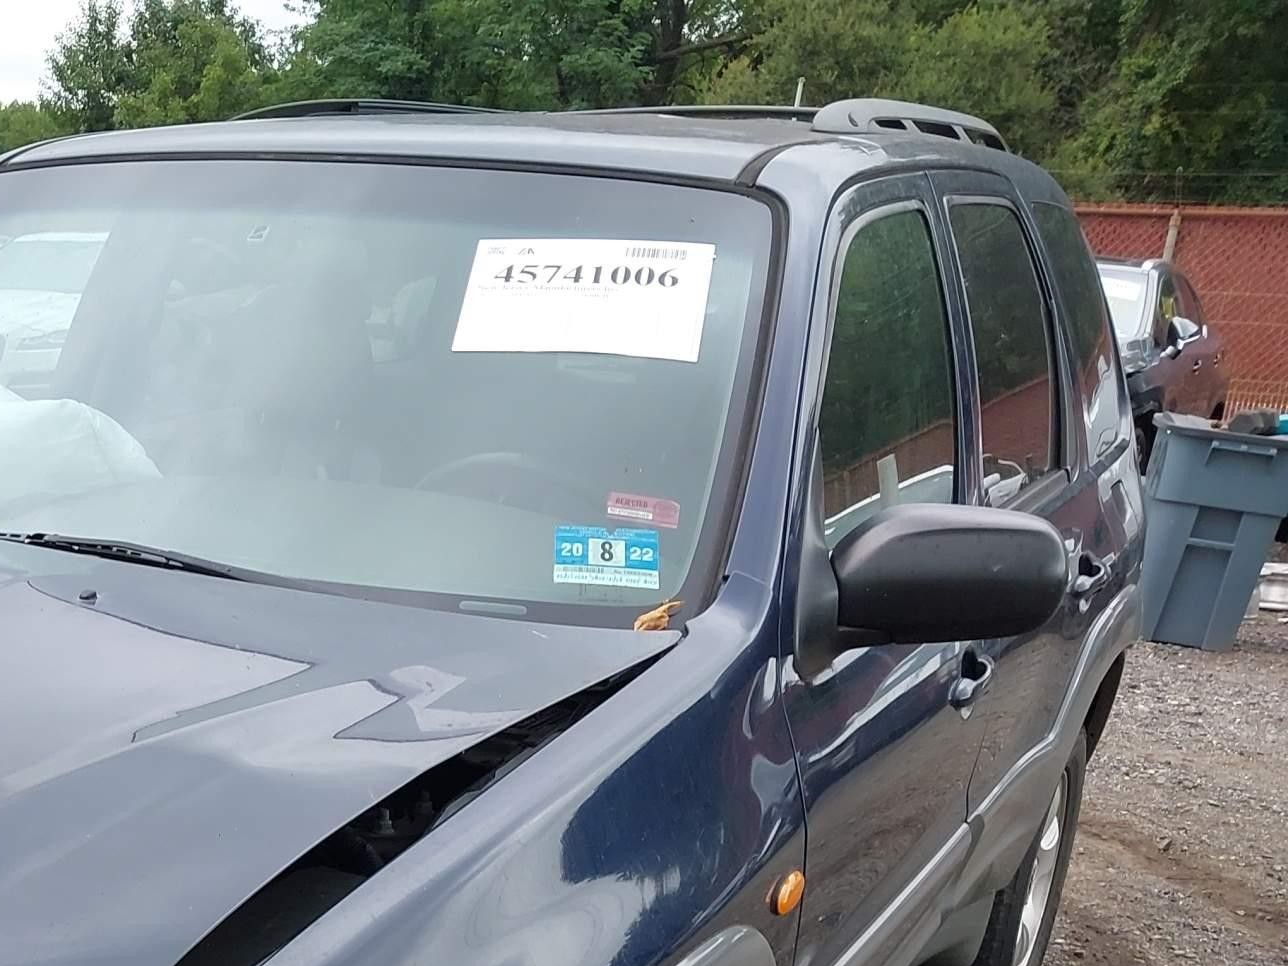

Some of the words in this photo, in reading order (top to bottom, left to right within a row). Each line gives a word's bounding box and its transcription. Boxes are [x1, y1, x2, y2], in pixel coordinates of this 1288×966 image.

[493, 263, 680, 288] 45741006
[560, 542, 584, 557] 20
[600, 541, 614, 562] 8
[629, 546, 654, 562] 22
